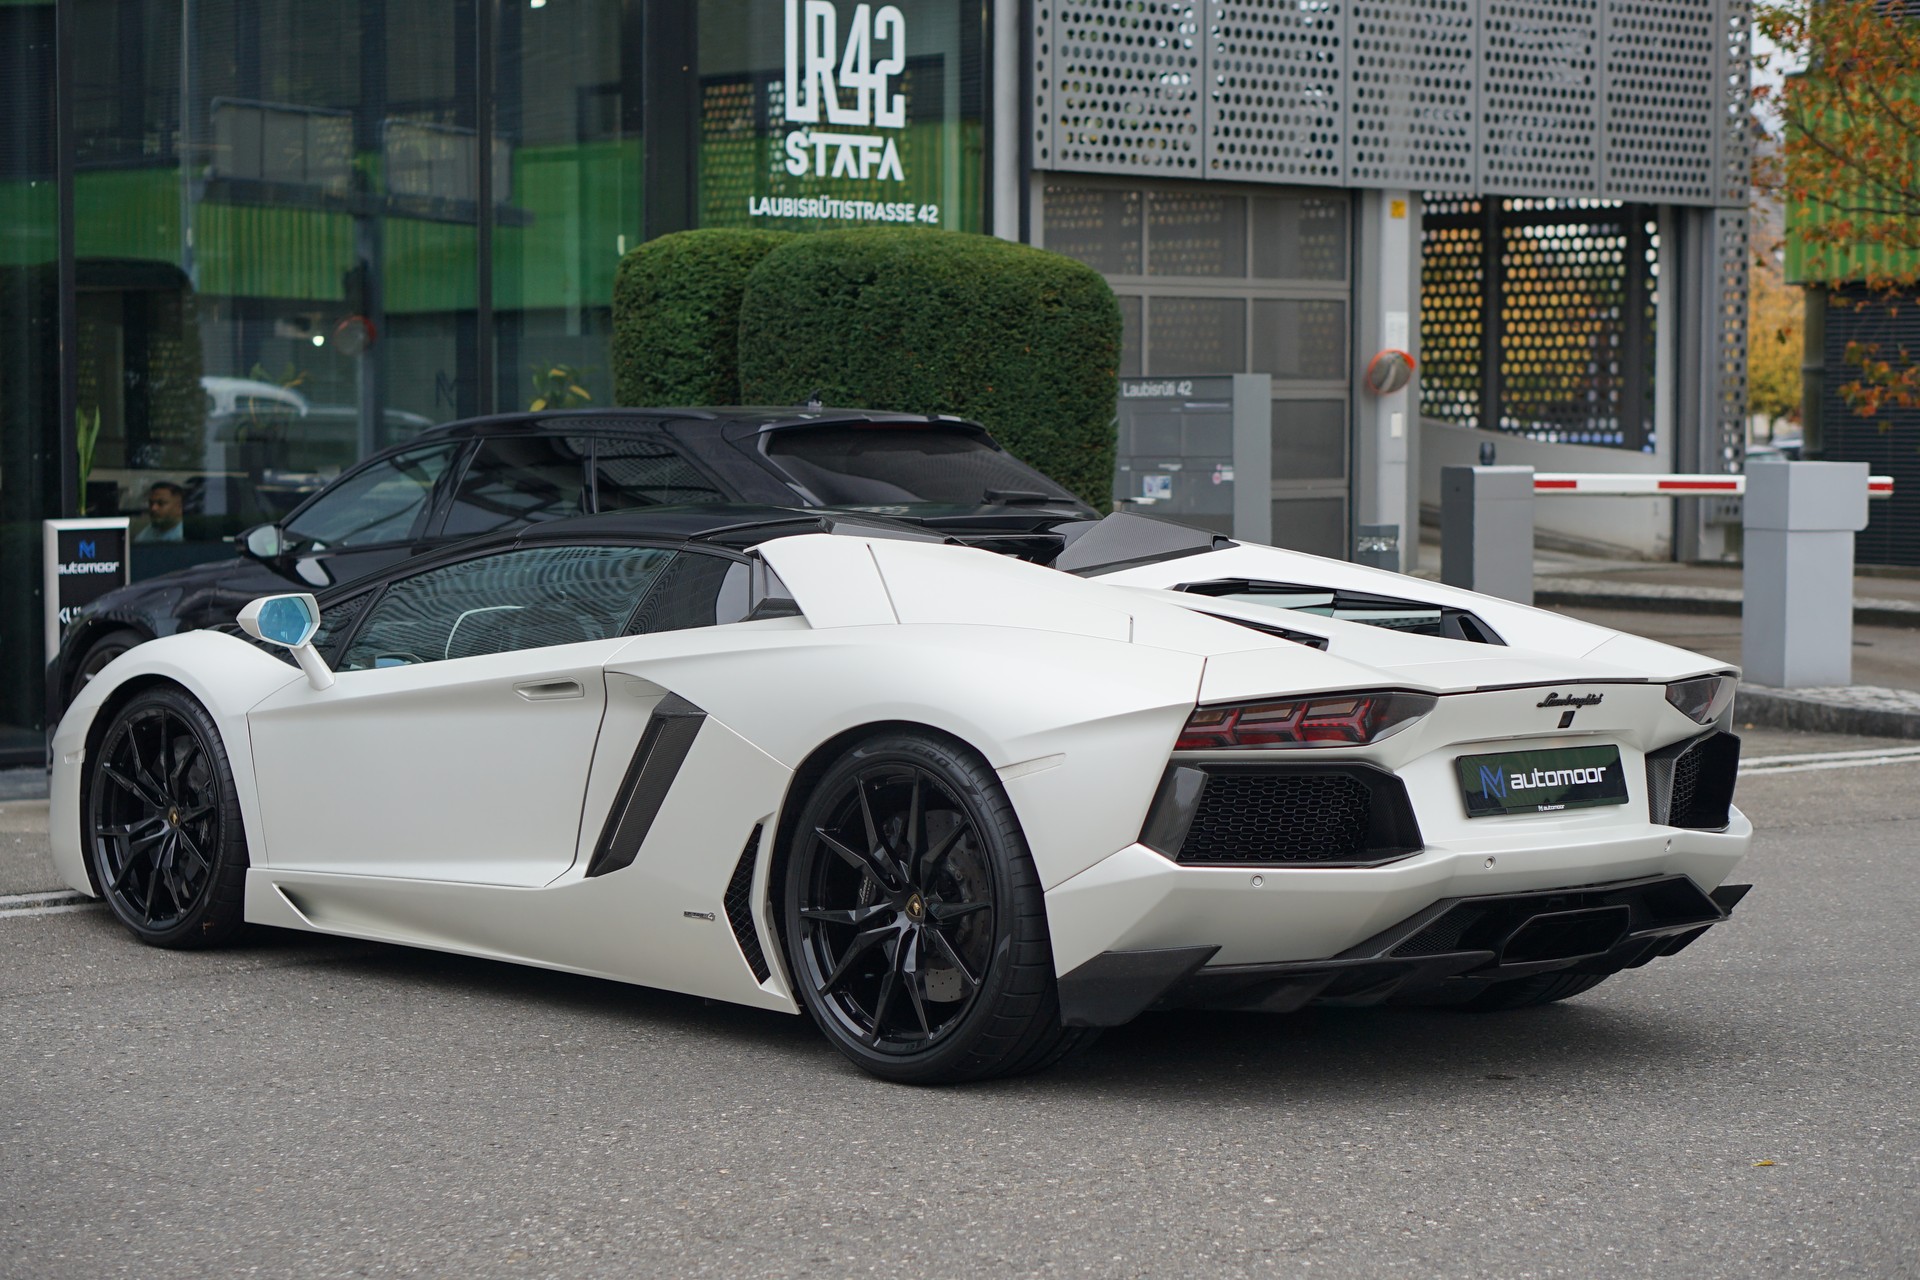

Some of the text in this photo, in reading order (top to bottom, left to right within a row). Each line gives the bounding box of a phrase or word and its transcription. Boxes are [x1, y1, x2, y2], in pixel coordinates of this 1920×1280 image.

[785, 0, 906, 128] LR42
[749, 195, 939, 223] LAUBISRÜTISTRASSE 42
[1176, 380, 1193, 396] 42
[58, 561, 119, 575] automoor
[1510, 766, 1607, 790] automoor
